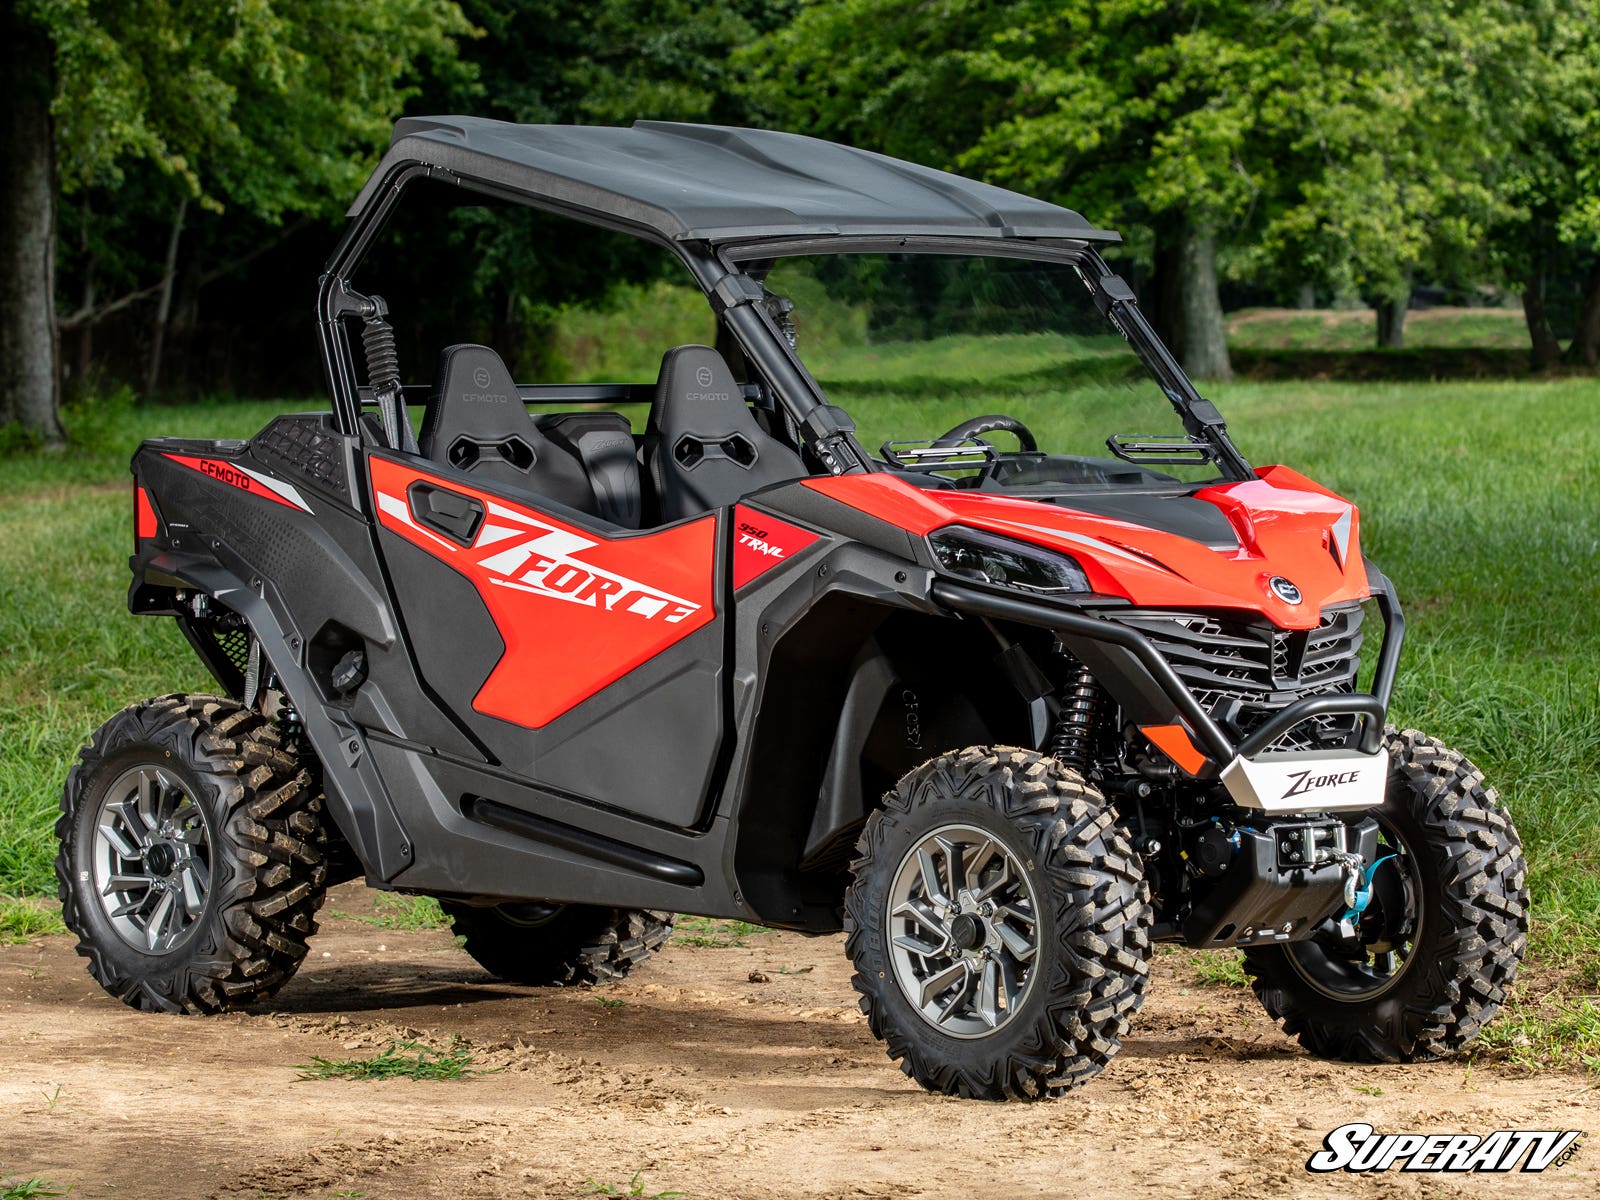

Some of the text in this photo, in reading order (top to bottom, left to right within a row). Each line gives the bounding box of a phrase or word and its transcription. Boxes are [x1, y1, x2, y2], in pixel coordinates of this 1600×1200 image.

[462, 393, 508, 404] CFMOTO
[686, 392, 729, 401] CFMOTO
[199, 460, 250, 489] CFMOTO
[737, 523, 769, 539] 950
[738, 534, 785, 558] TRAIL
